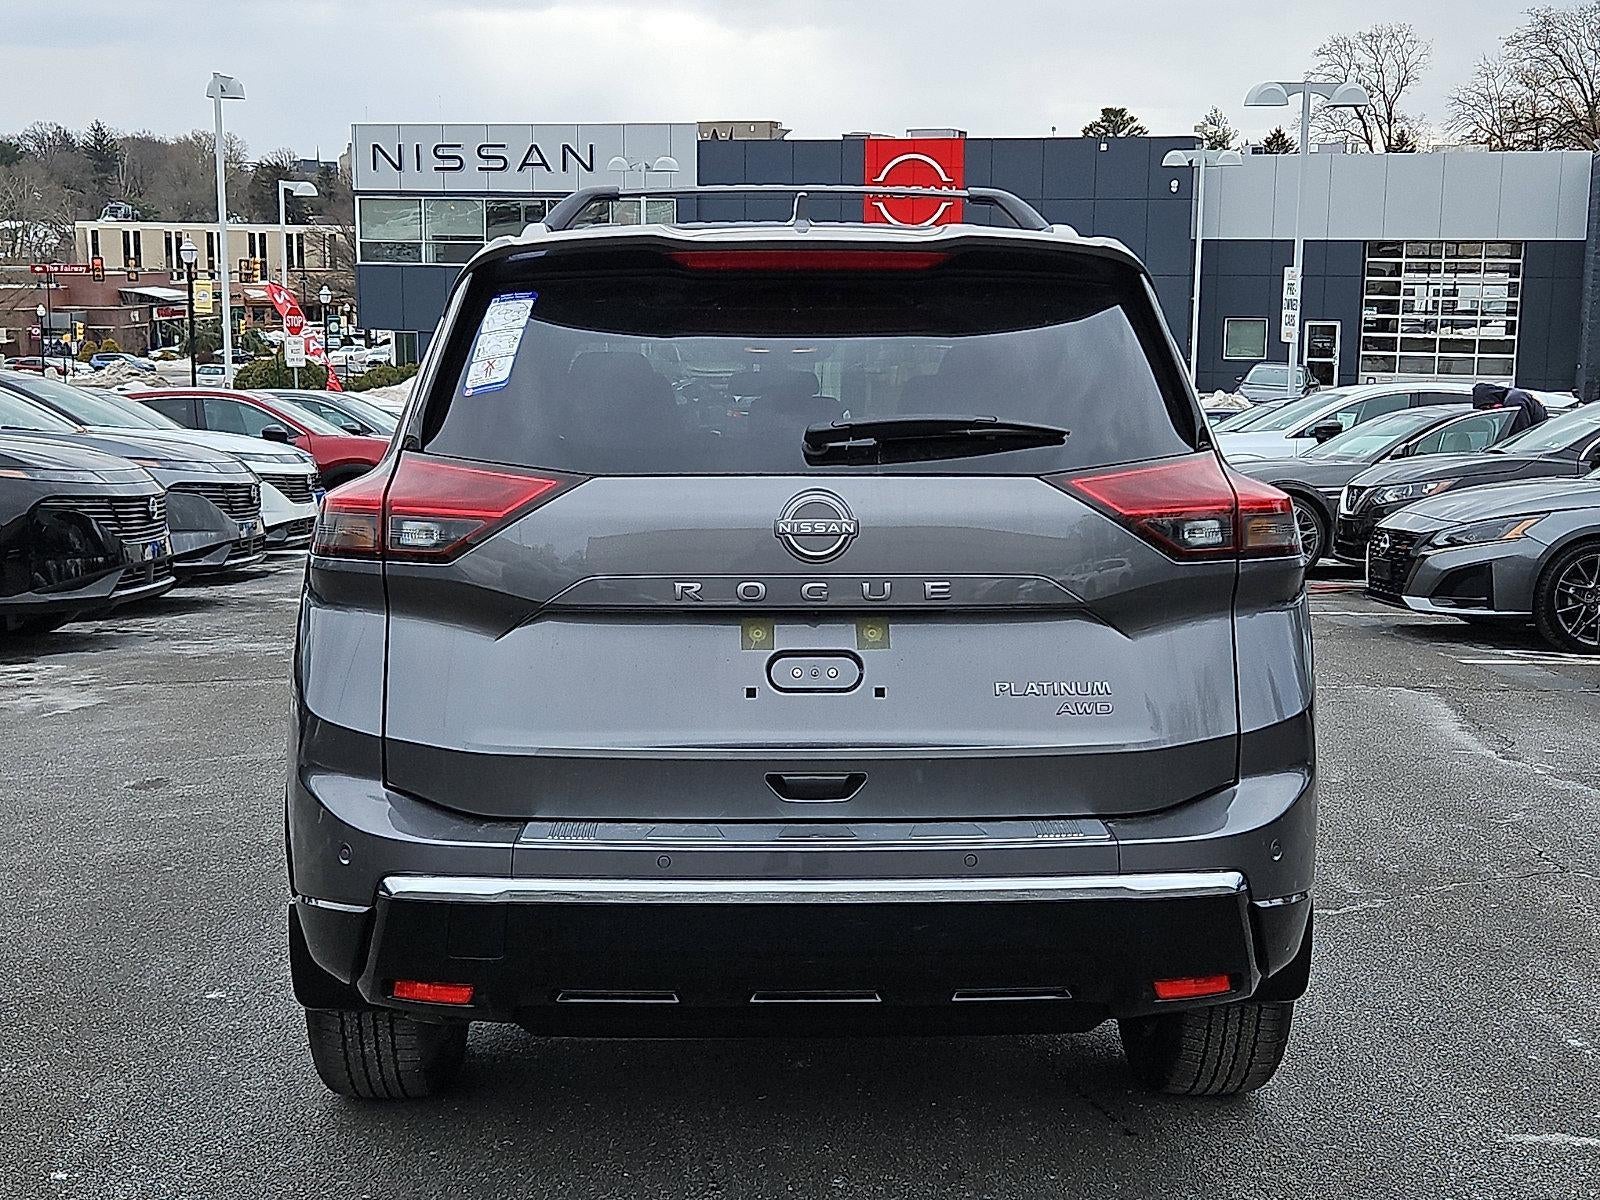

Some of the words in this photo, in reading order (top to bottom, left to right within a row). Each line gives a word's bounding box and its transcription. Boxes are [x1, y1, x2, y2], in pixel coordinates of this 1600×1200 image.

[371, 143, 595, 173] NISSAN
[60, 264, 87, 273] Fairway
[286, 315, 303, 328] STOP
[777, 521, 856, 534] NISSAN
[673, 580, 952, 602] ROGUE
[993, 680, 1113, 698] PLATINUM
[1056, 701, 1114, 716] AWD
